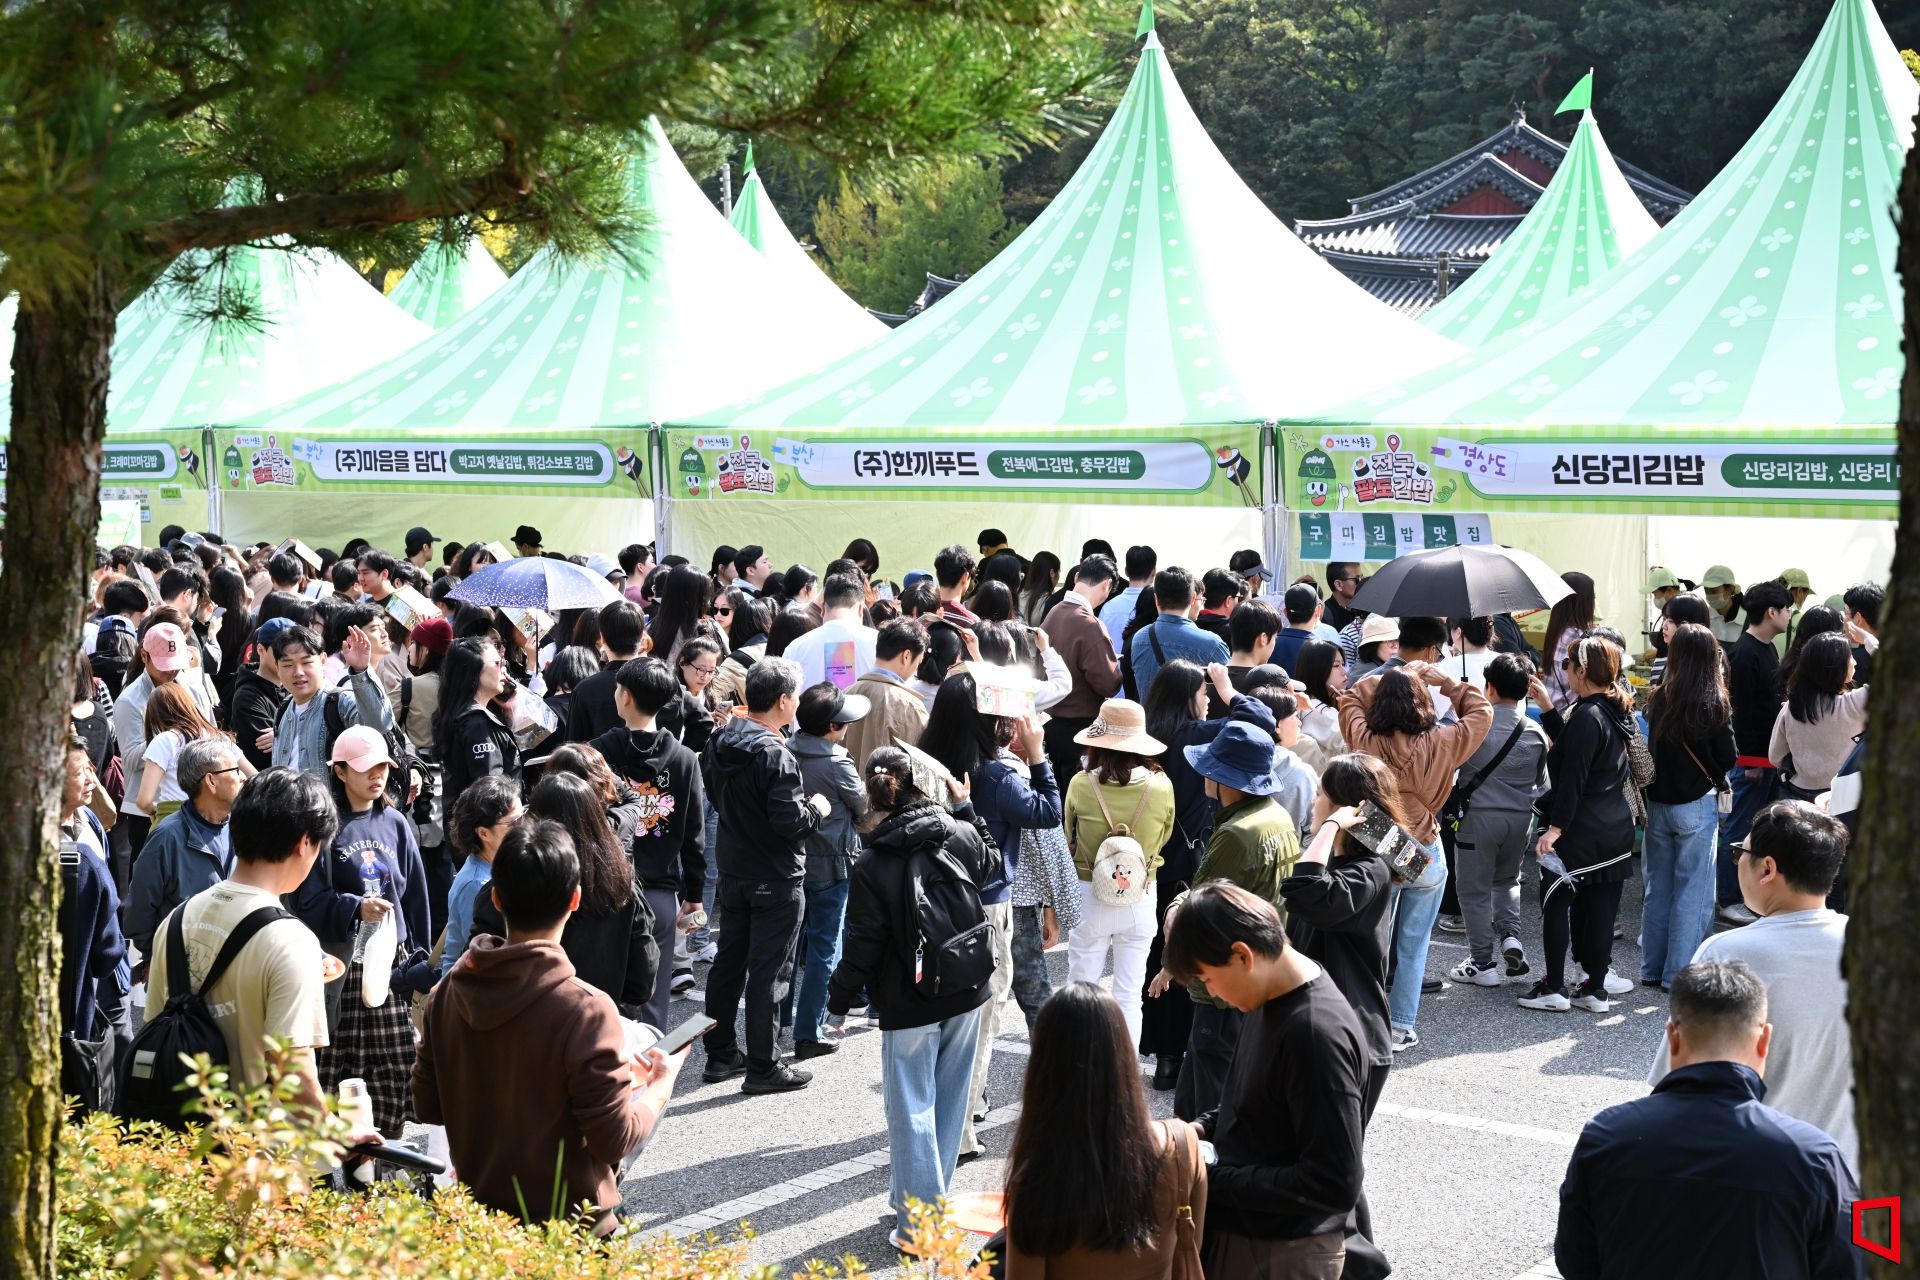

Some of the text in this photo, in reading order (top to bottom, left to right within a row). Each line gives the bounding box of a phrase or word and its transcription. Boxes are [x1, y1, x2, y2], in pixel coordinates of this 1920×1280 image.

[306, 443, 324, 460] 부산
[1352, 438, 1371, 448] 사용중
[110, 455, 158, 468] 크레미꼬마김밥
[335, 449, 447, 473] (주)마음을 담다
[458, 455, 594, 471] 박고지 옛날김밥, 튀김소보로 김밥
[730, 450, 760, 472] 전국
[792, 444, 815, 465] 부산
[854, 450, 980, 477] (주)한끼푸드
[1001, 456, 1131, 474] 전복에그김밥, 충무김밥
[1371, 453, 1415, 478] 전국
[1458, 445, 1507, 477] 경상도
[1552, 454, 1705, 486] 신당리김밥
[1742, 461, 1834, 483] 신당리김밥,
[1838, 462, 1892, 483] 신당리
[719, 471, 774, 493] 팔도김밥
[1354, 477, 1434, 503] 팔도김밥
[168, 641, 176, 652] B
[340, 840, 396, 862] SKATEBOARD
